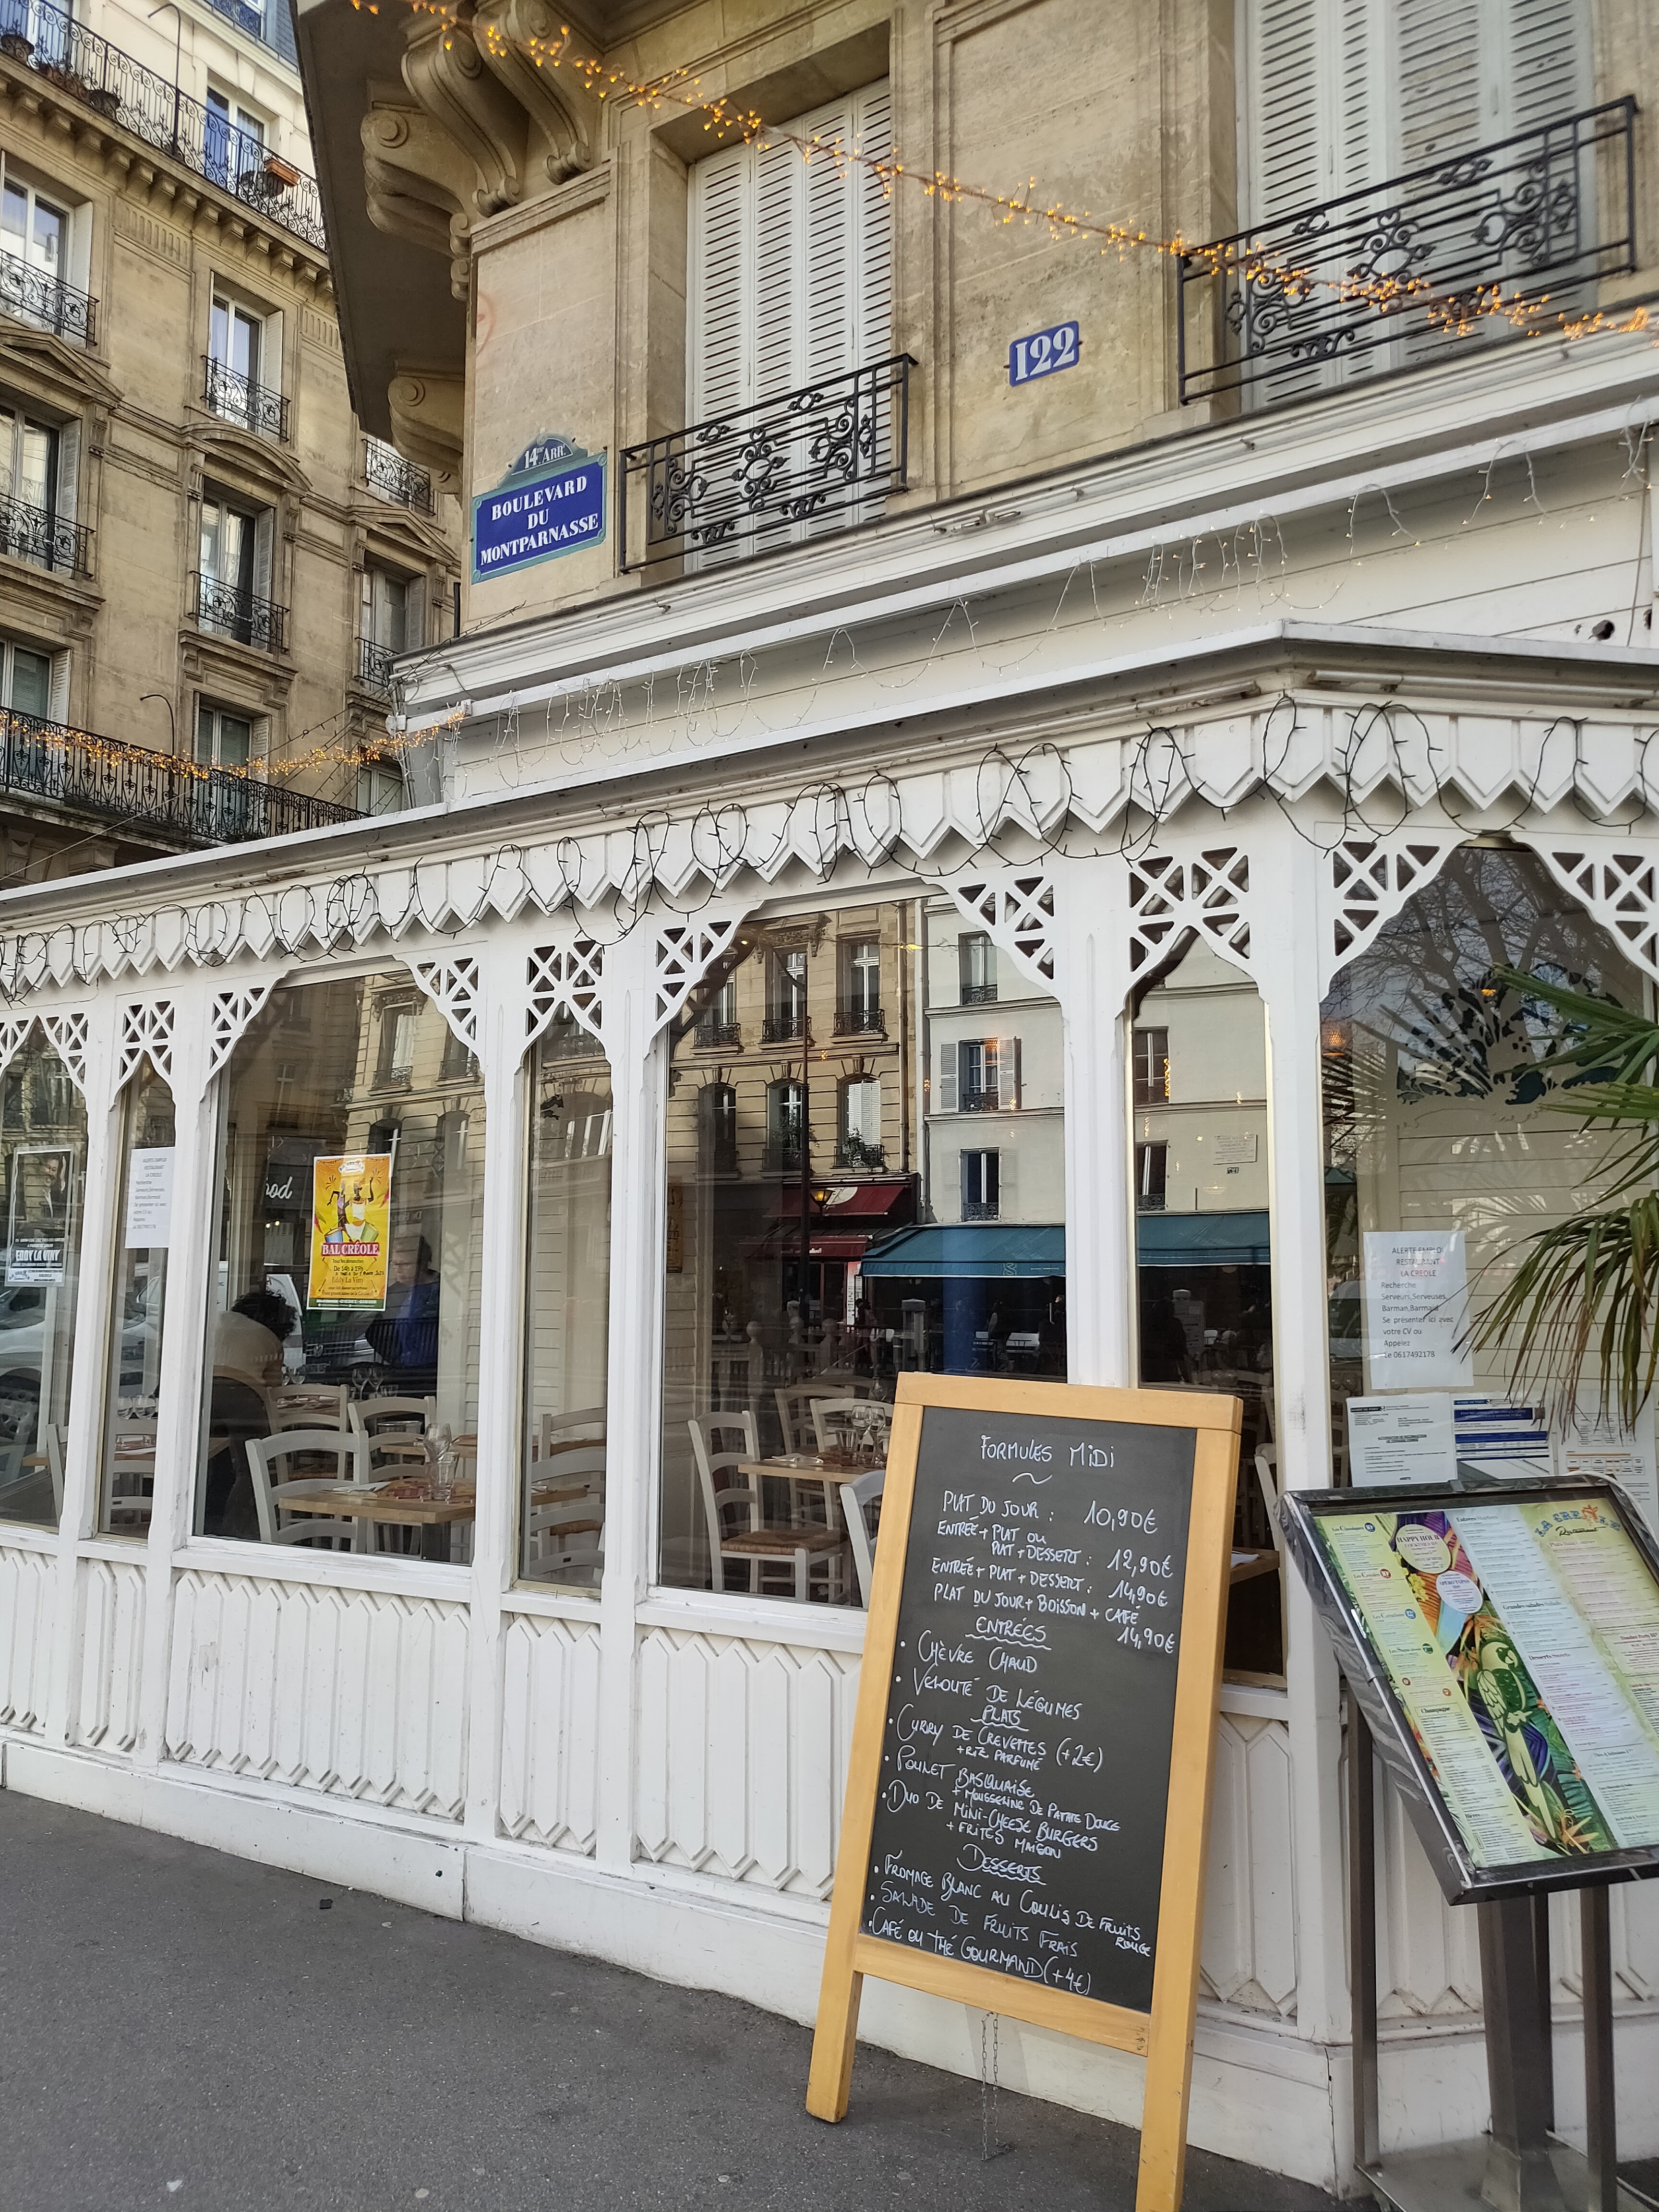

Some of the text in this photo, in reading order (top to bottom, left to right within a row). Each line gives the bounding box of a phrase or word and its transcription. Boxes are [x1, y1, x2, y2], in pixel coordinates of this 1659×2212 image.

[1015, 327, 1074, 381] 122
[491, 476, 588, 521] BOULEVARD
[527, 508, 549, 529] DU
[480, 513, 599, 566] MONTPARNASSE
[322, 1242, 379, 1254] BAL CRÉOLE
[981, 1435, 1052, 1462] FORMULES
[943, 1490, 975, 1513] PLAT
[980, 1496, 996, 1515] DU
[1001, 1501, 1039, 1519] JOUR
[1083, 1500, 1158, 1534] 10,90€
[1535, 1520, 1553, 1537] LA
[992, 1524, 1021, 1541] PLAT
[992, 1541, 1015, 1557] PLAT
[1026, 1544, 1082, 1564] DESSERT
[1106, 1549, 1174, 1578] 12,90€
[934, 1583, 965, 1602] PLAT
[973, 1589, 991, 1607] DU
[994, 1592, 1025, 1609] JOUR
[1105, 1606, 1140, 1625] CAFÉ
[988, 1564, 1017, 1582] PLAT
[1029, 1571, 1085, 1593] DESSERT
[1107, 1580, 1169, 1607] 14,90€
[976, 1616, 1047, 1642] ENTRÉES
[1117, 1626, 1176, 1654] 14,90€
[918, 1630, 1038, 1673] CHÈVRE CHAUD
[914, 1662, 1083, 1720] VELOUTÉ DE LÉGUMES
[982, 1705, 1022, 1724] PLATS
[896, 1703, 1104, 1773] CURRY DE CREVETTES (+2€)
[897, 1744, 956, 1779] POULET
[994, 1753, 1044, 1771] PARFUMÉ
[887, 1779, 919, 1814] DUO
[925, 1792, 944, 1811] DE
[1036, 1823, 1098, 1852] BURGERS
[1029, 1800, 1044, 1816] DE
[956, 1843, 1041, 1881] DESSERTS
[880, 1880, 936, 1917] SALADE
[949, 1904, 969, 1925] DE
[884, 1850, 934, 1888] FROMAGE
[941, 1872, 983, 1902] BLANC
[991, 1890, 1010, 1907] AU
[1075, 1910, 1095, 1929] DE
[871, 1906, 905, 1940] CAFÉ
[926, 1931, 958, 1957] THÉ
[960, 1936, 1043, 1979] GOURMAND
[1115, 1936, 1152, 1958] ROUGE
